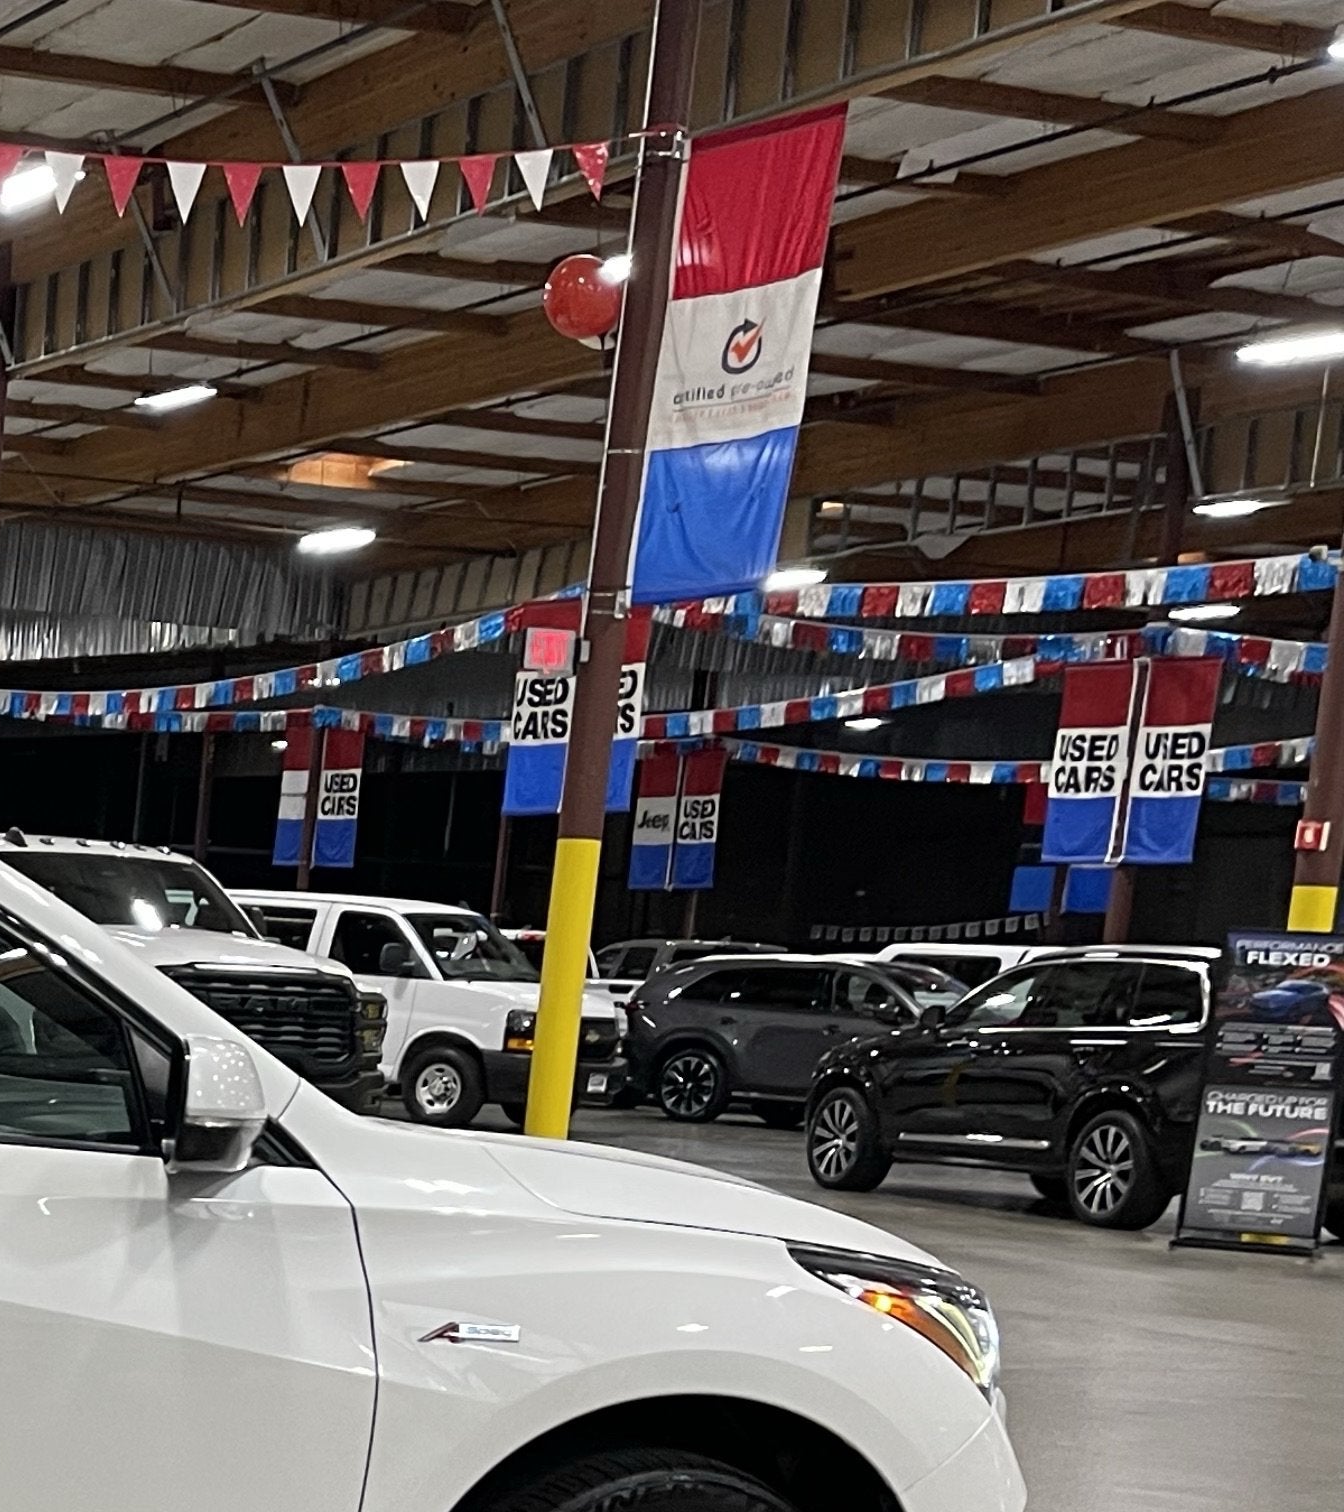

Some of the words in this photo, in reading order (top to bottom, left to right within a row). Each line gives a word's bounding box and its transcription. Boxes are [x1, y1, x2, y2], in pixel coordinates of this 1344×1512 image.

[516, 677, 569, 707] USED
[513, 708, 568, 740] CARS
[1060, 734, 1119, 762] USED
[324, 772, 358, 793] USED
[1055, 765, 1116, 793] CARS
[1139, 762, 1203, 792] CARS
[683, 799, 716, 819] USED
[1235, 939, 1344, 955] PERFORMANCE
[1246, 950, 1331, 967] FLEXED
[1206, 1100, 1246, 1115] THE
[1247, 1103, 1328, 1121] FUTURE
